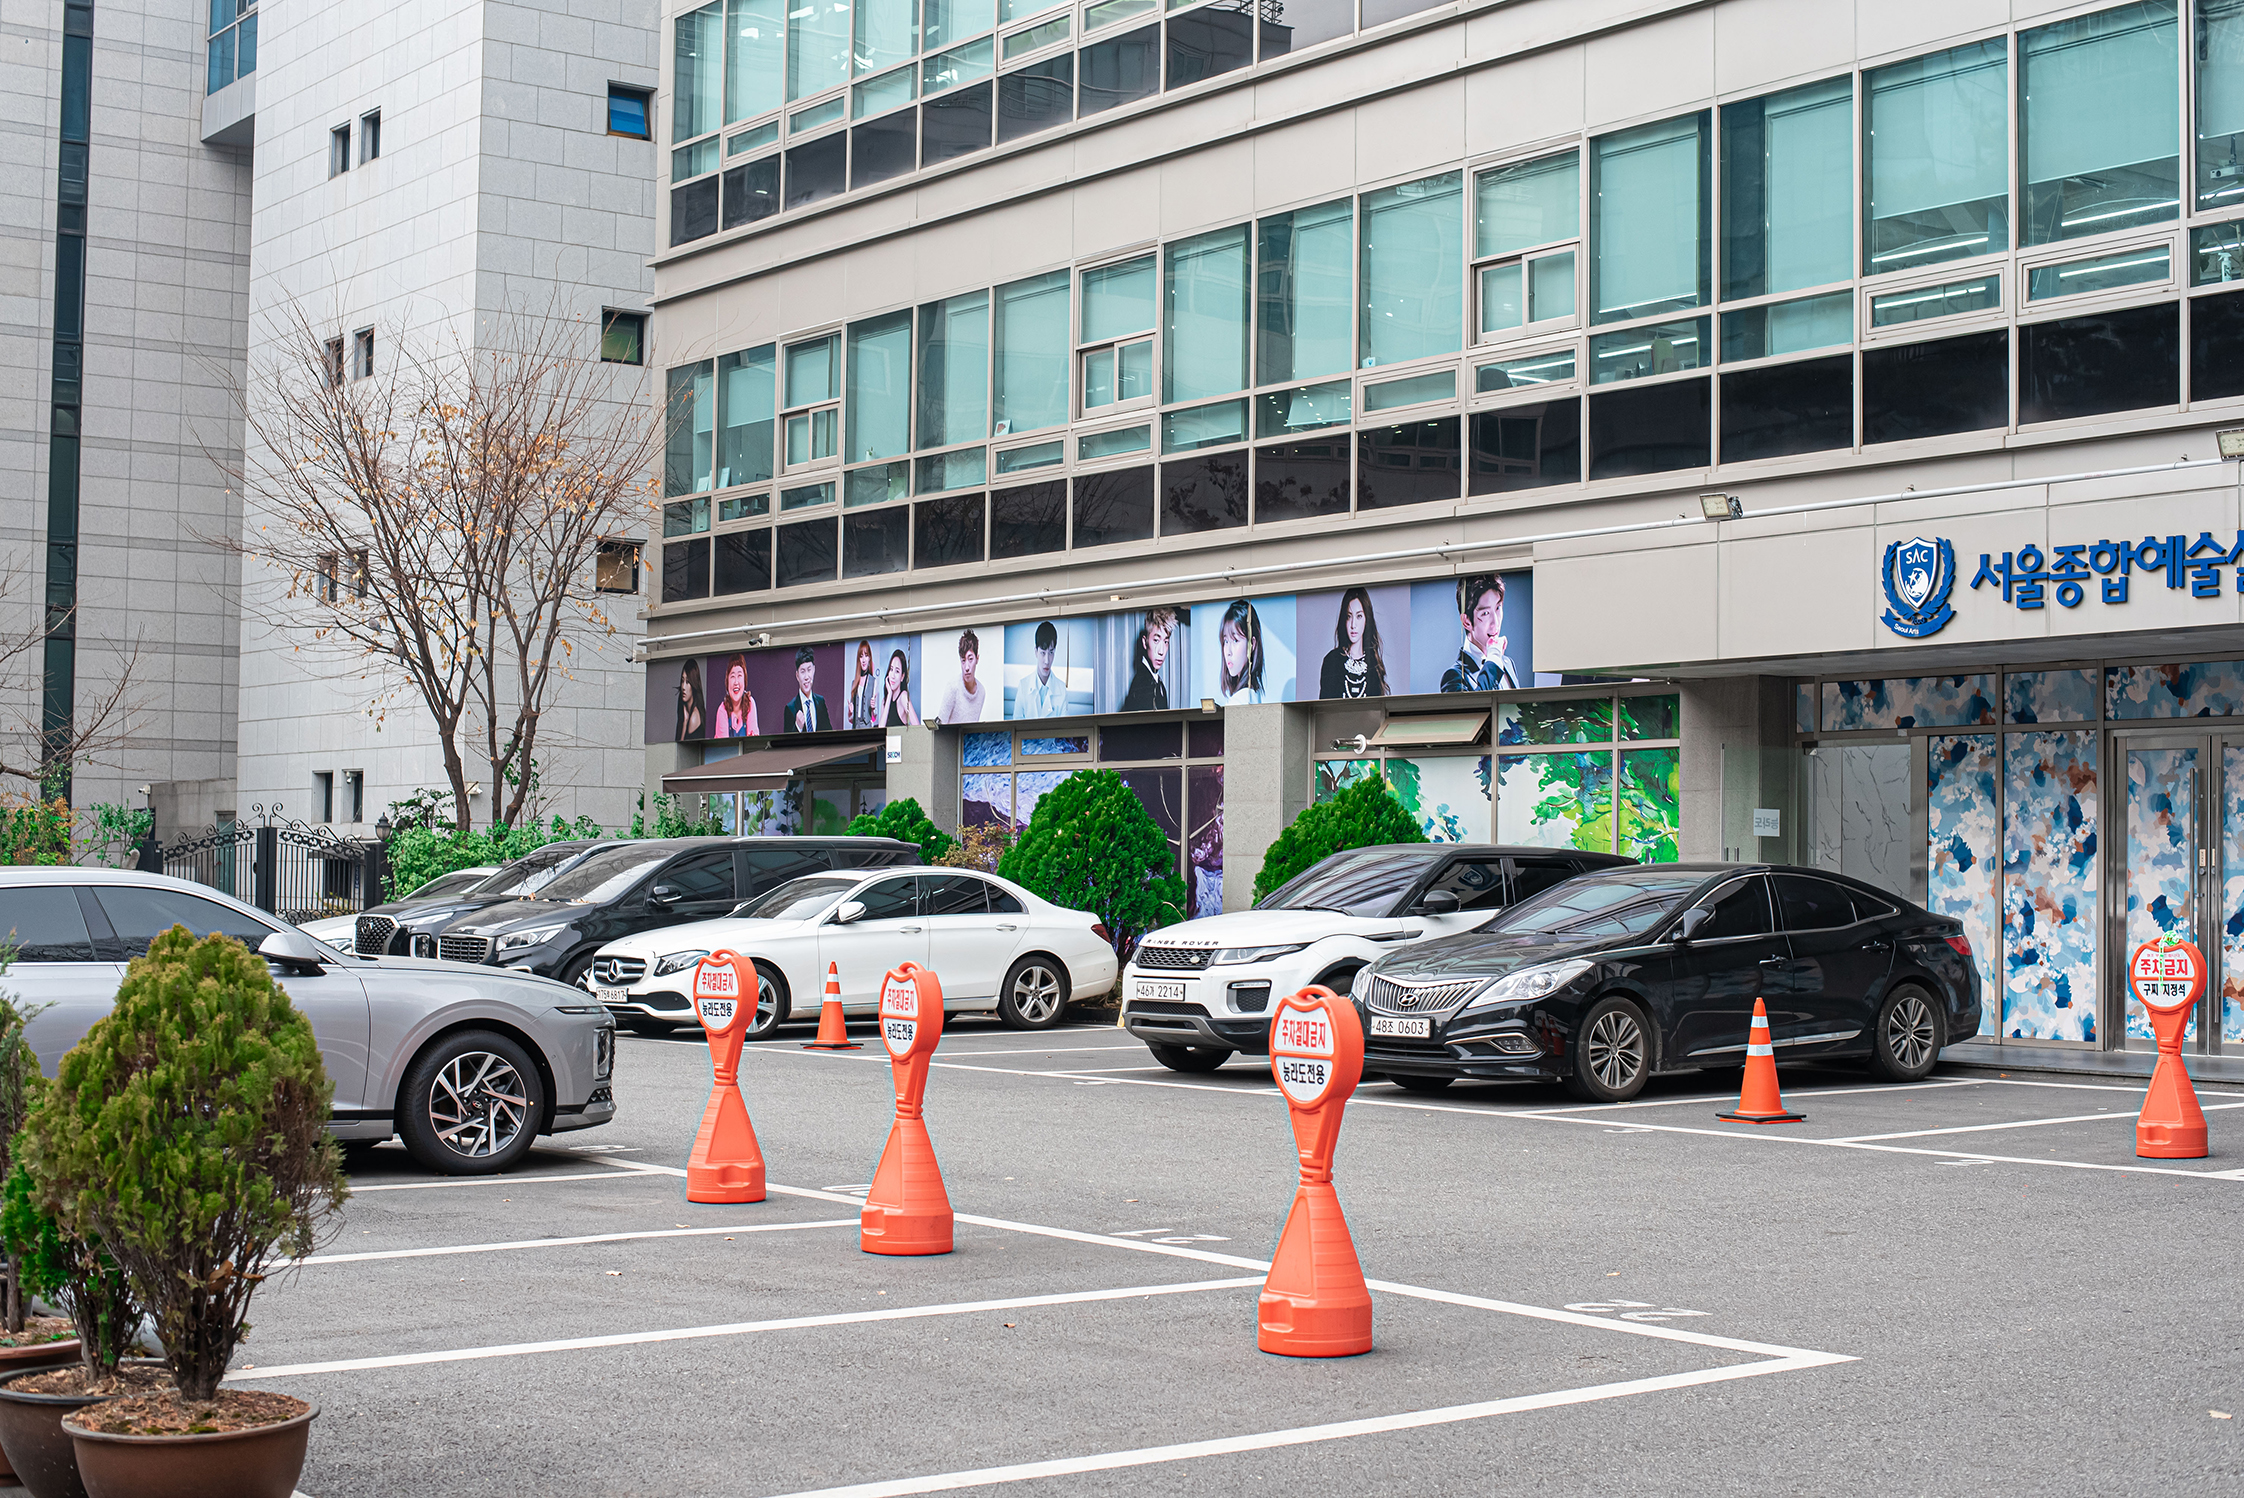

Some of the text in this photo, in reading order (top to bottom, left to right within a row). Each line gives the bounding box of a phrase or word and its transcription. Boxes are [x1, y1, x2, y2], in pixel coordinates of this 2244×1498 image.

[1905, 548, 1929, 564] SAC
[1894, 623, 1908, 634] Seoul
[702, 972, 734, 991] 주차절대금지
[887, 988, 915, 1011] 주차절대금지
[1158, 985, 1179, 998] 2214
[702, 1001, 733, 1017] 능라도전용
[887, 1022, 913, 1041] 능라도전용
[1282, 1019, 1326, 1049] 주차절대금지
[1375, 1019, 1424, 1035] 48조 0603
[1283, 1061, 1325, 1085] 능라도전용
